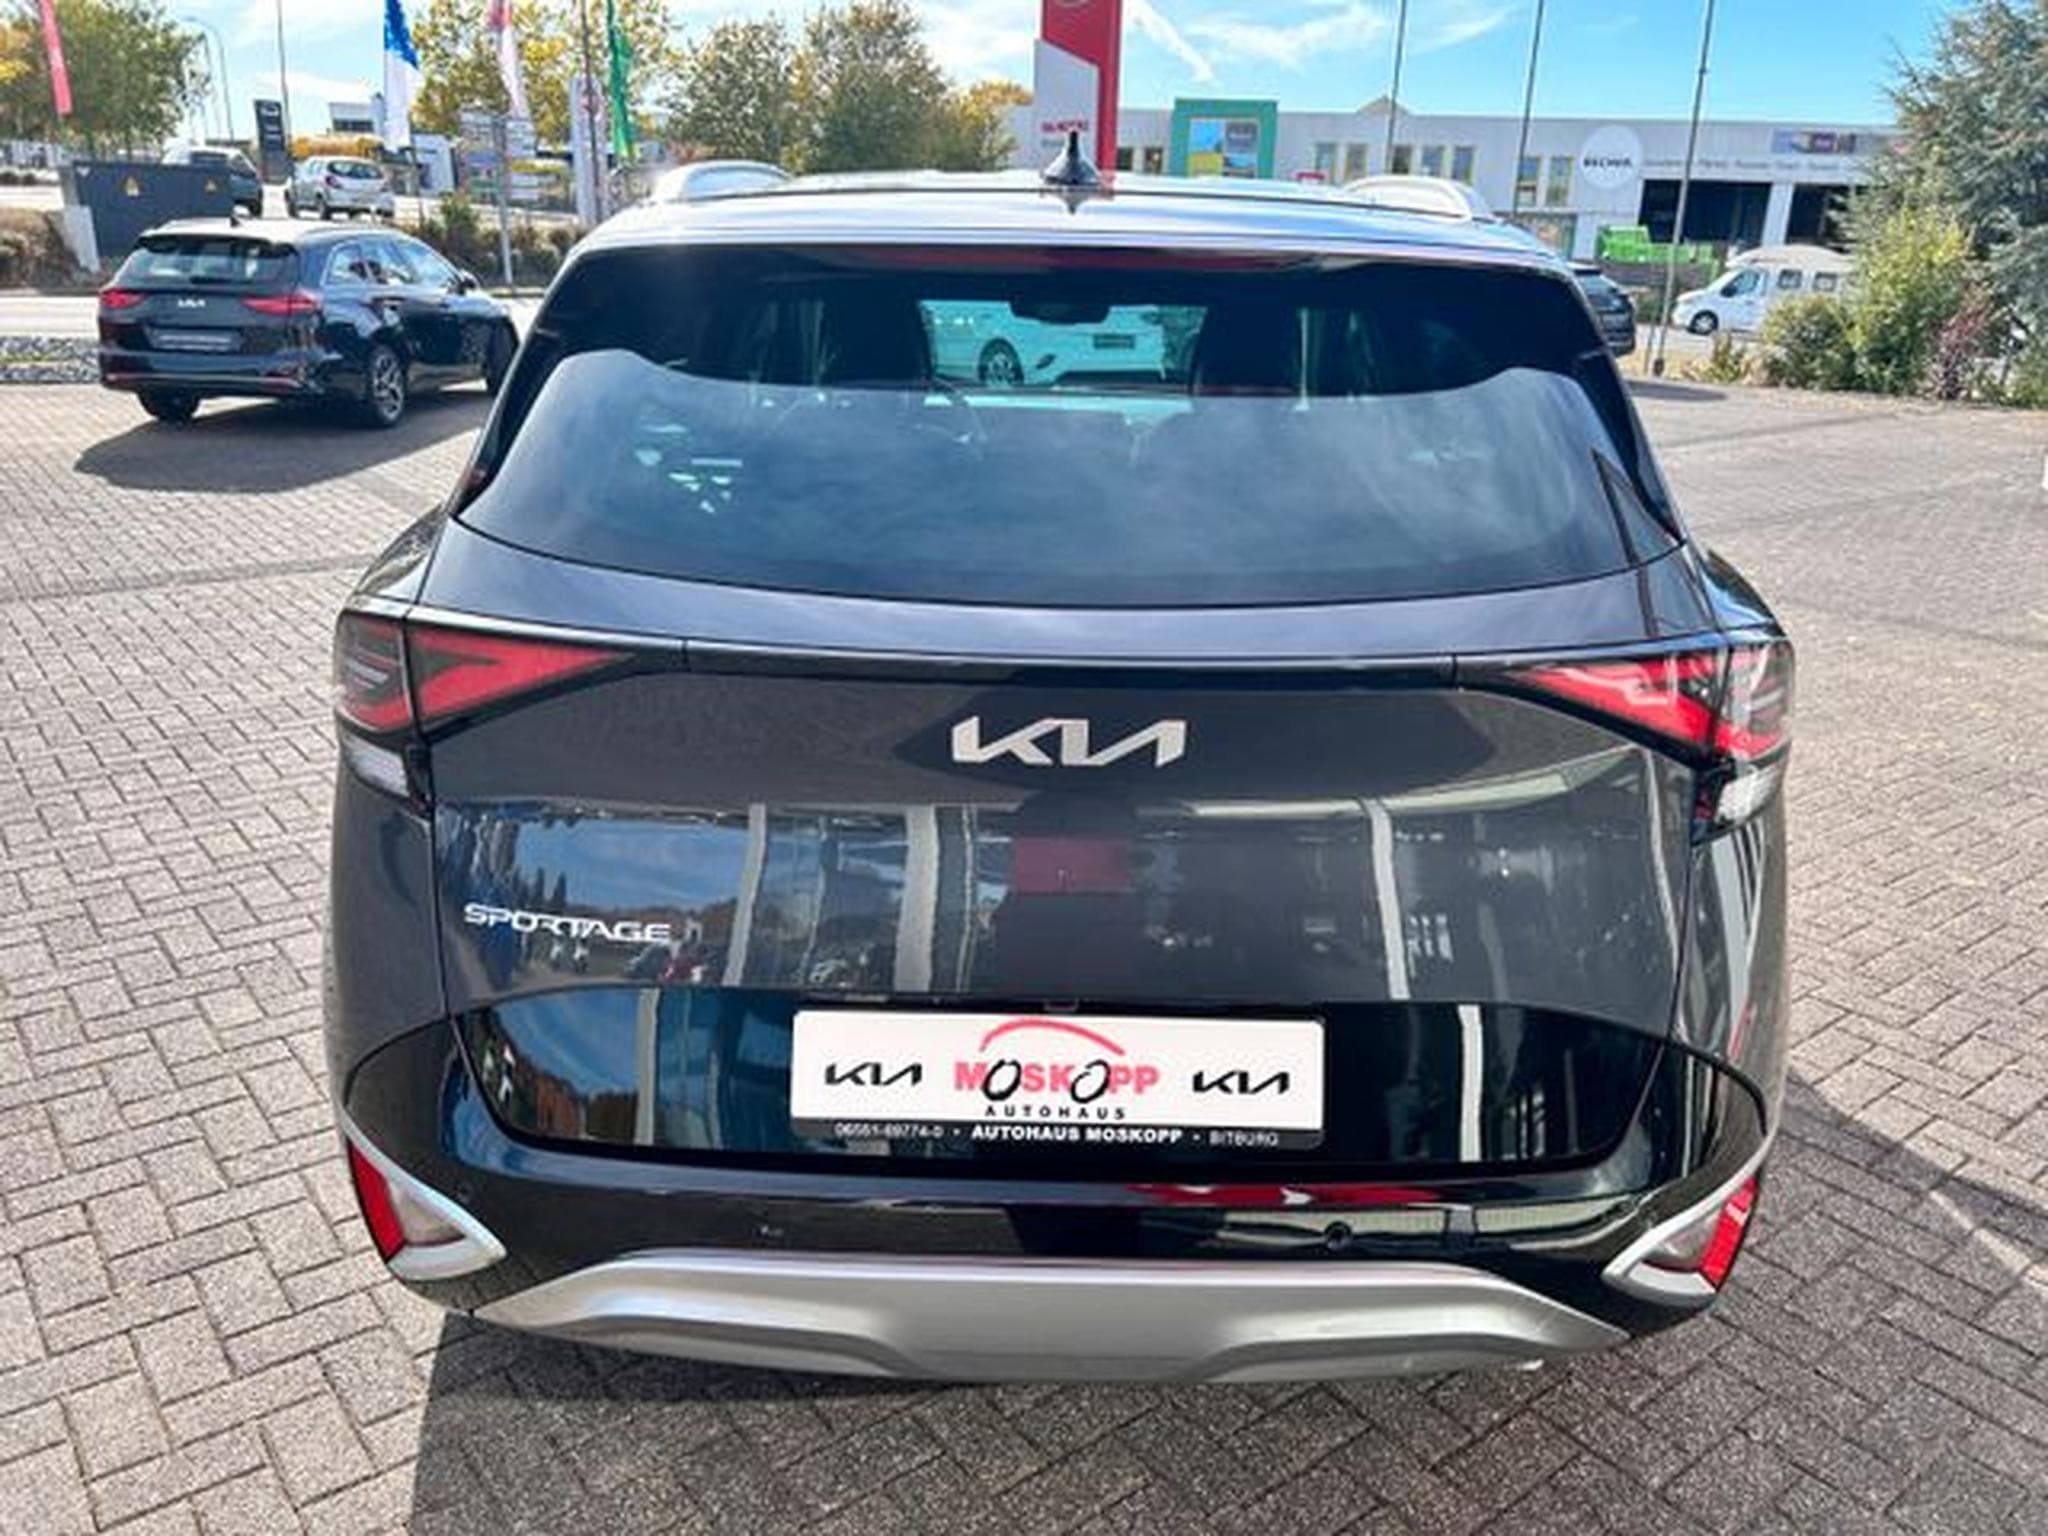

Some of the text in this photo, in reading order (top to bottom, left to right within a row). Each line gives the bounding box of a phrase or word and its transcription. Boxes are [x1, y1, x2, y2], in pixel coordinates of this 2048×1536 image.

[950, 715, 1187, 768] KIA
[464, 903, 672, 944] SPORTAGE
[825, 1062, 923, 1087] KIA
[953, 1058, 1160, 1103] MOSKOPP
[1193, 1069, 1290, 1095] KIA
[985, 1104, 1127, 1121] AUTOHAUS
[971, 1124, 1081, 1142] AUTOHAUS
[1085, 1126, 1184, 1145] MOSKOPP
[1208, 1129, 1280, 1148] BITBURG
